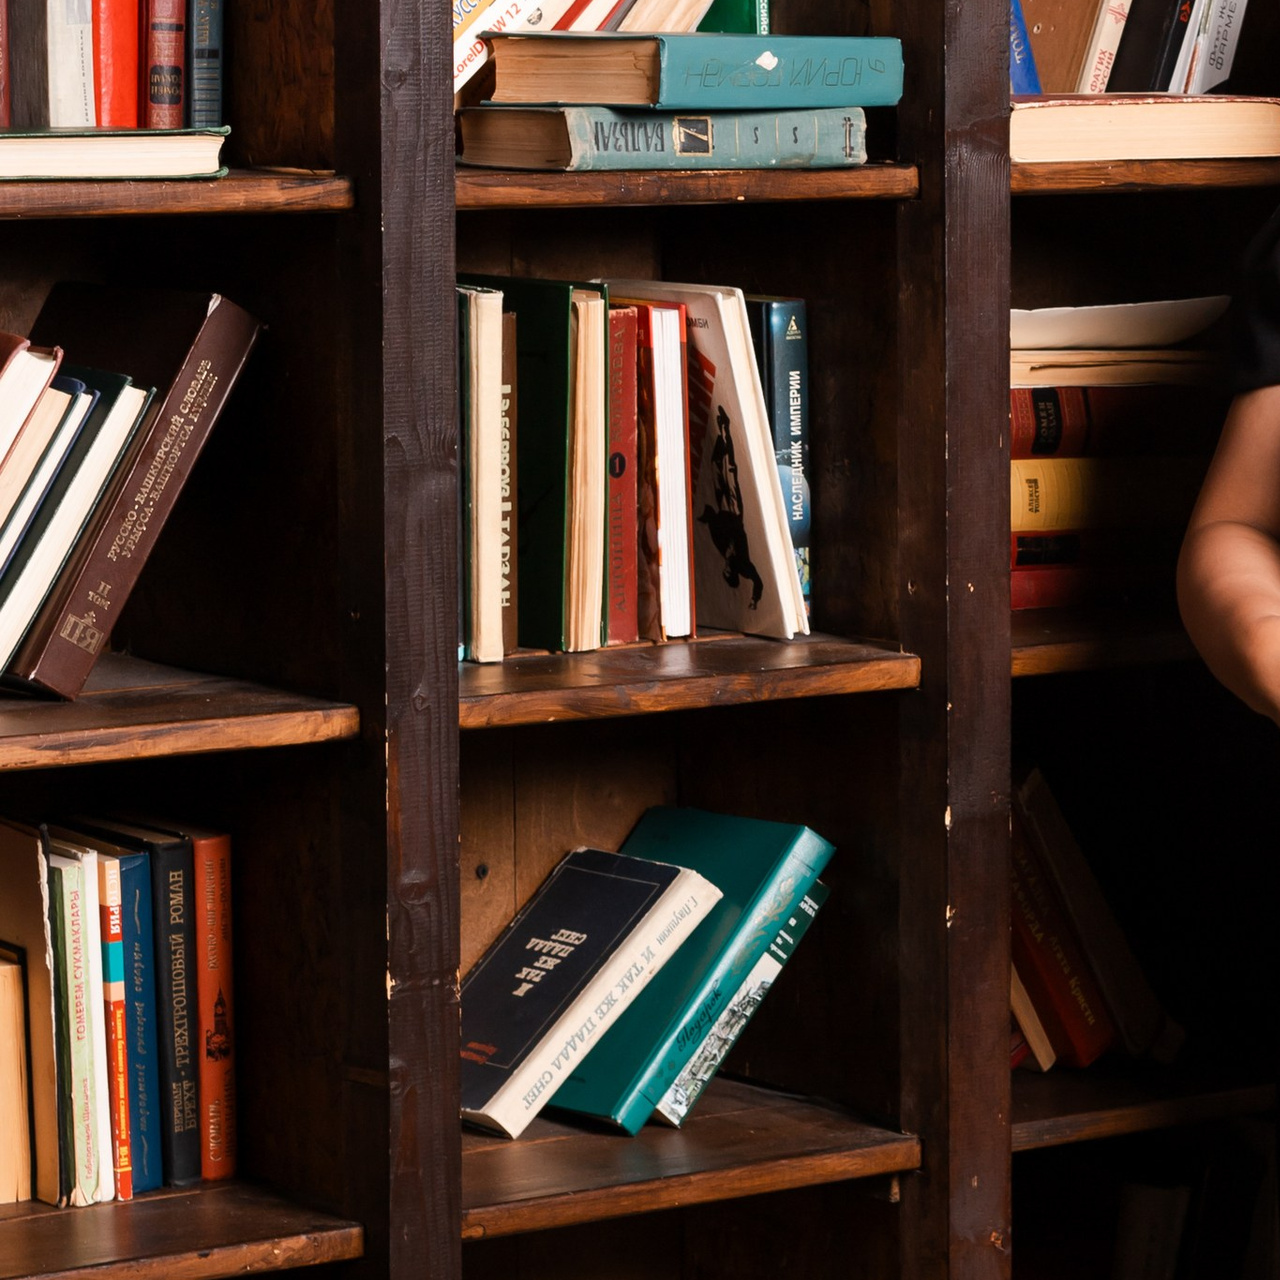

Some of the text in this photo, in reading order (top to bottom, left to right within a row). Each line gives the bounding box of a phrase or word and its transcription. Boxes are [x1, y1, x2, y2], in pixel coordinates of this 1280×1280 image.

[453, 2, 523, 79] CorelDAW 12
[789, 57, 863, 88] ЮРИЙ
[1090, 47, 1108, 93] ФАТИХ
[179, 359, 212, 414] СЛОВАРЬ
[789, 370, 804, 521] НАСЛЕДНИК ИМПЕРИИ
[611, 491, 625, 613] АНТОНИНА
[87, 591, 111, 610] ТОМ
[108, 868, 122, 936] ИСТОРИЯ
[69, 888, 79, 980] СУКМАКЛАРЫ
[525, 937, 576, 956] ПАДАЛ
[550, 928, 588, 946] СНЕГ
[169, 870, 191, 1068] ТРЕХГРОШОВЫЙ РОМАН
[515, 966, 546, 983] ТАК
[534, 955, 562, 970] ЖЕ
[674, 979, 723, 1053] Подарок
[1068, 976, 1096, 1026] Кристи
[522, 948, 656, 1112] И ТАК ЖЕ ПАДАЛ СНЕГ
[173, 1081, 183, 1134] БЕРТОЛЬТ
[184, 1079, 197, 1129] БРЕХТ
[119, 1145, 128, 1168] 10-11
